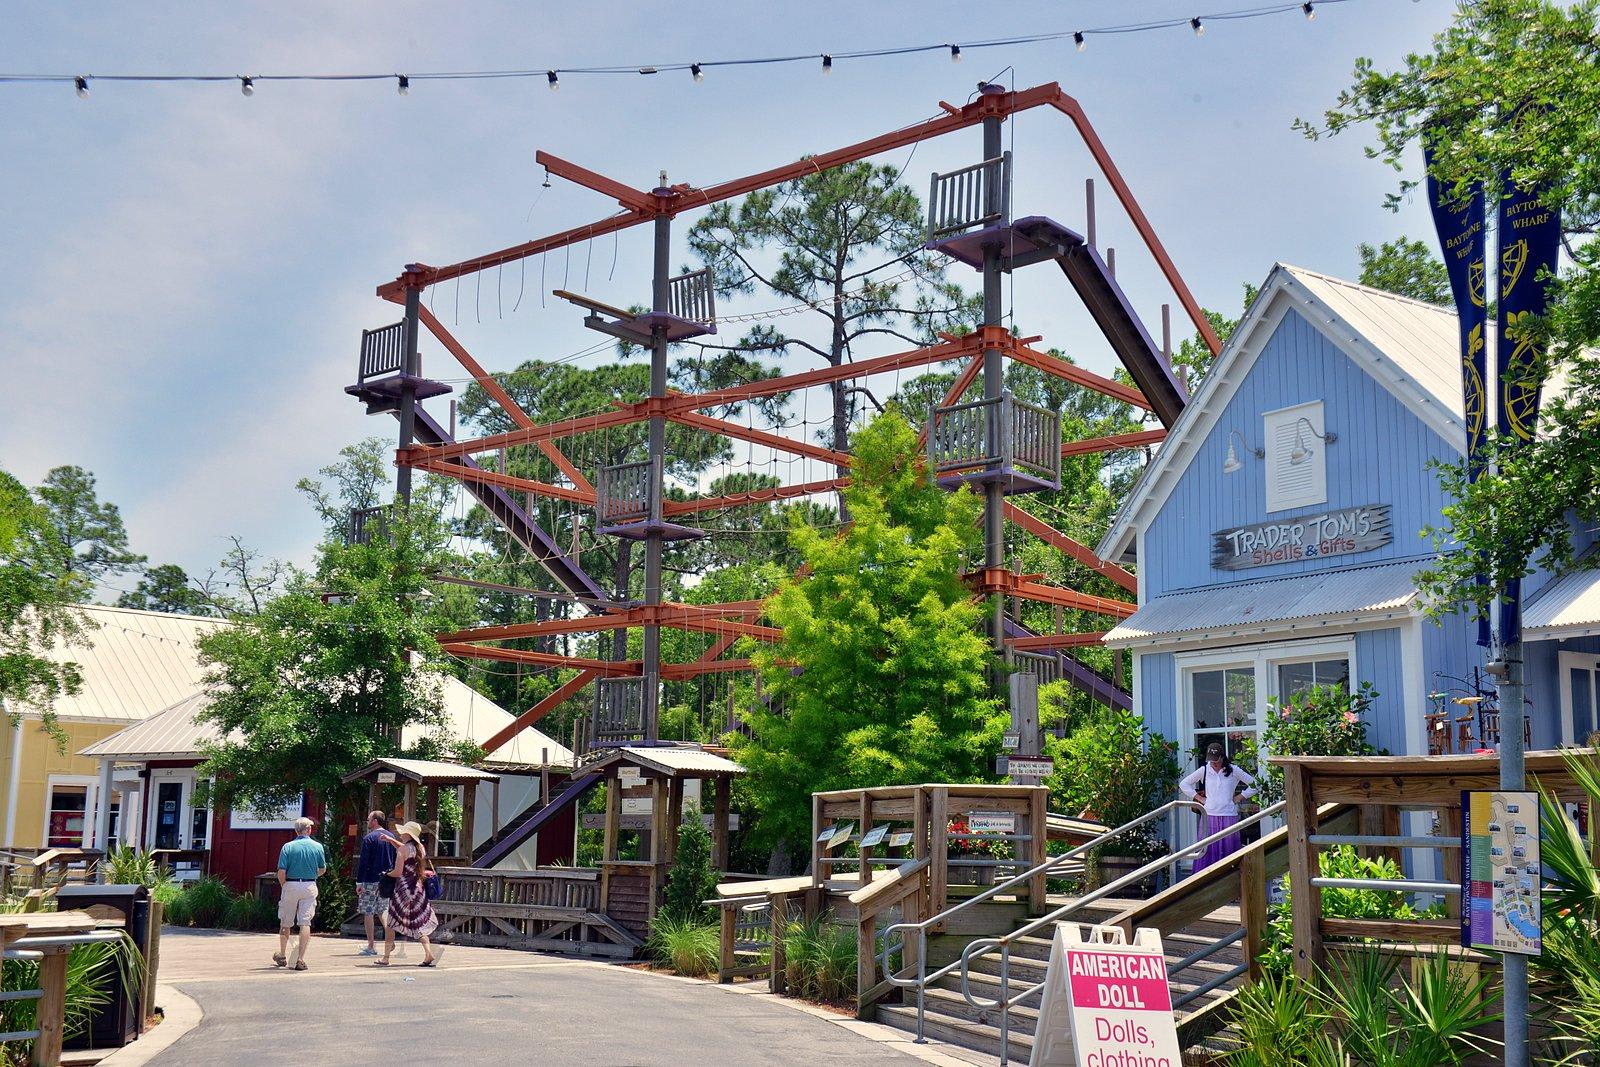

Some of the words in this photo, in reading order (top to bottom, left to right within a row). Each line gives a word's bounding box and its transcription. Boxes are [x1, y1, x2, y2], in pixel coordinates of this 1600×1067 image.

[1512, 212, 1550, 229] WHARF
[1226, 523, 1305, 557] TRADER
[1309, 509, 1372, 546] TOM'S
[1252, 544, 1303, 566] Shells
[1305, 546, 1318, 557] &
[1319, 538, 1356, 556] Gifts
[1072, 953, 1164, 980] AMERICAN
[1097, 983, 1145, 1009] DOLL
[1095, 1017, 1155, 1048] Dolls,
